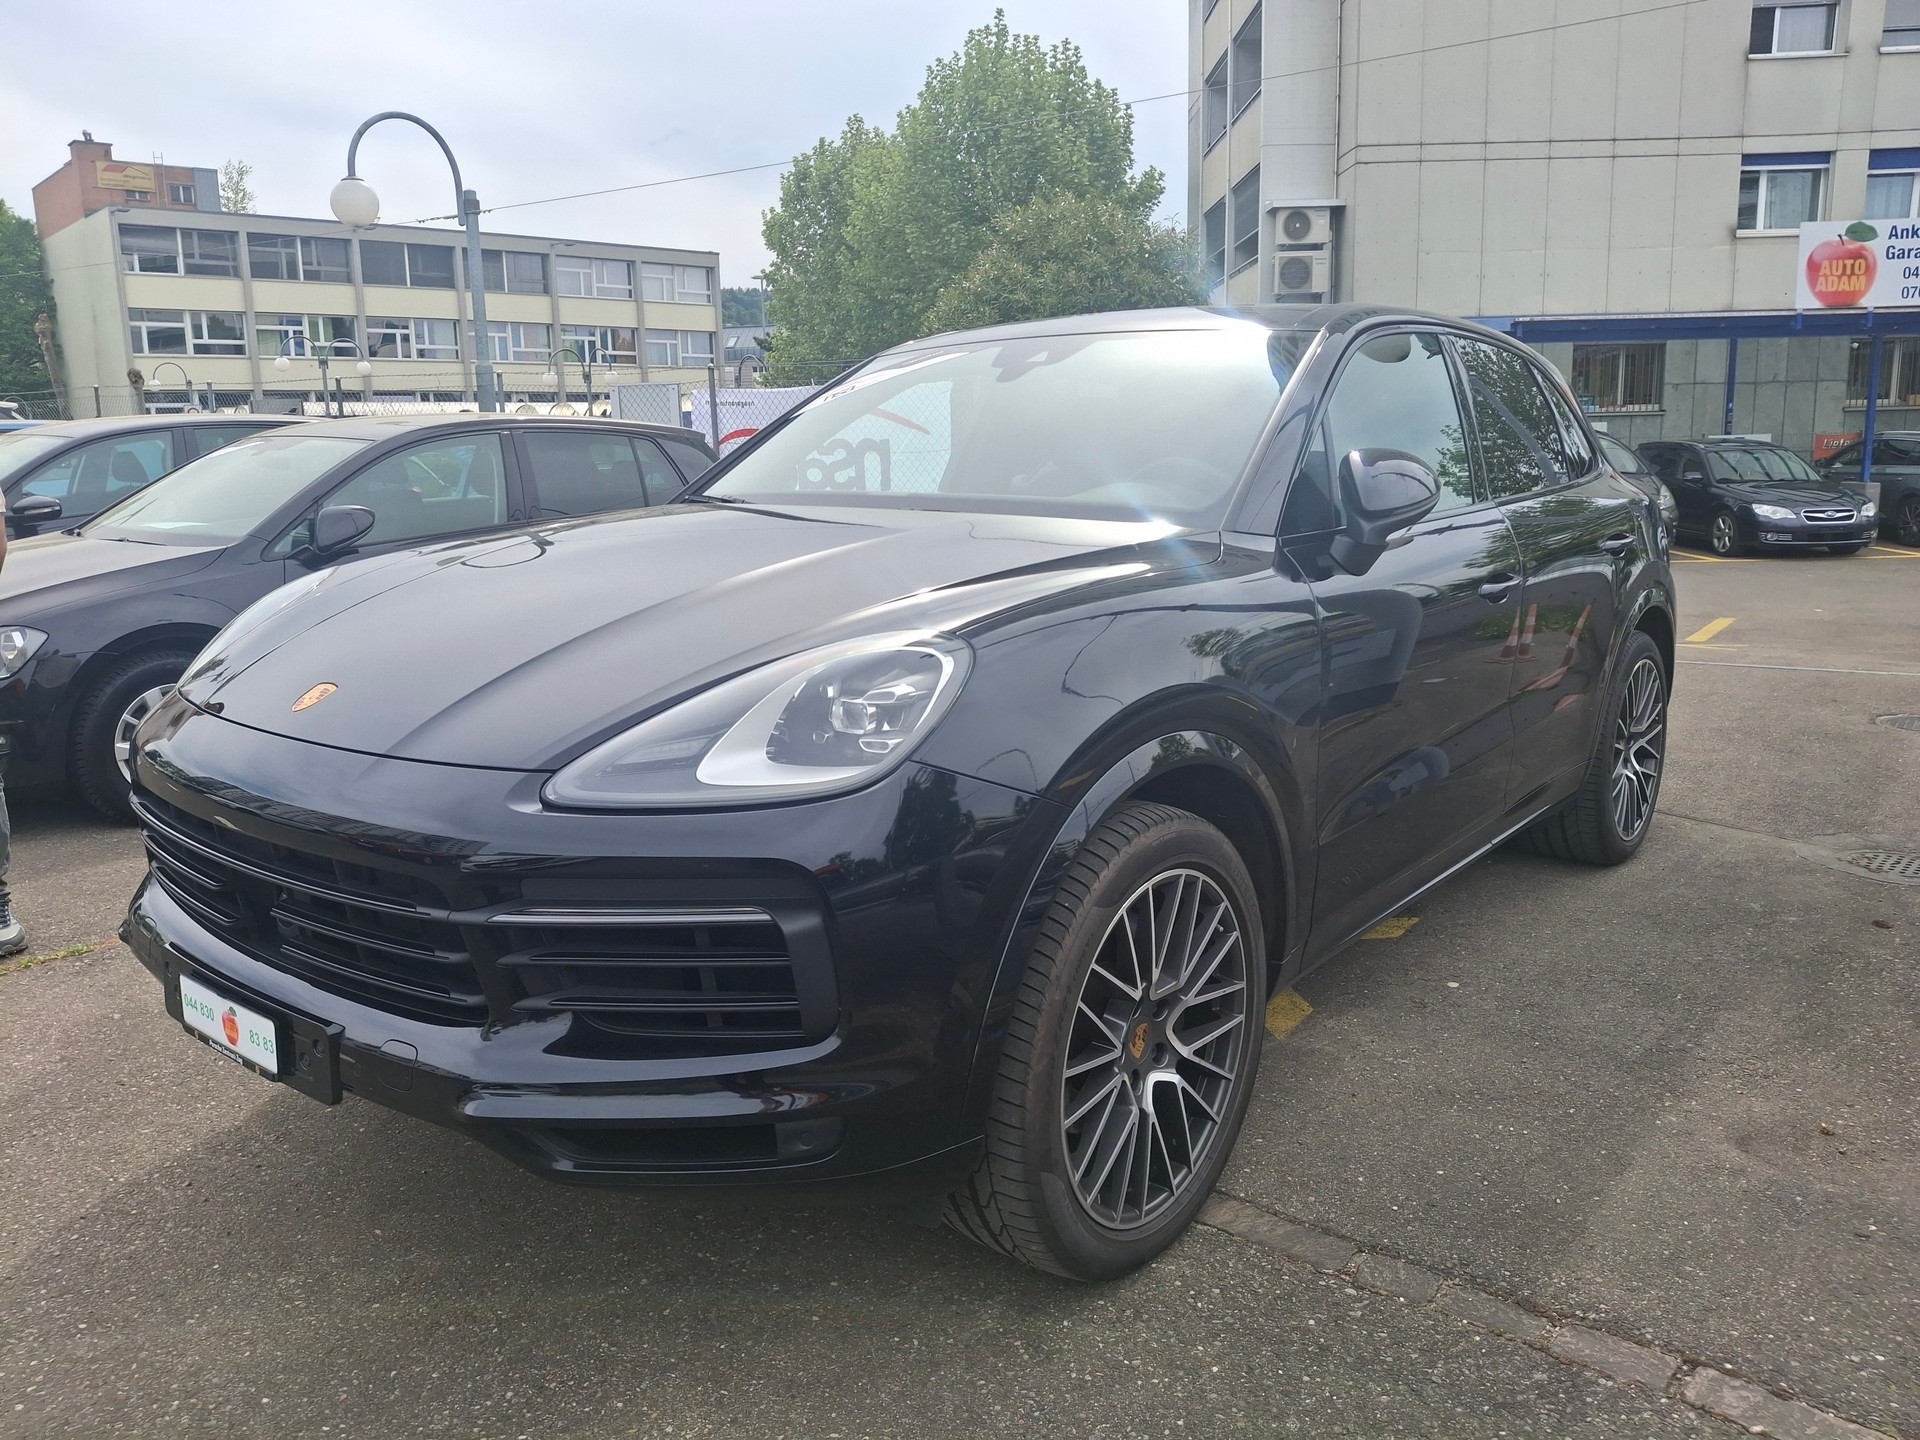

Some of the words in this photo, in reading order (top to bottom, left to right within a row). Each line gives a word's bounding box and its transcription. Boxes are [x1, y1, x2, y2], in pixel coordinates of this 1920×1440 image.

[1819, 259, 1866, 276] AUTO
[1815, 275, 1866, 292] ADAM
[1901, 285, 1920, 299] 07
[184, 993, 198, 1012] 044
[200, 1002, 214, 1021] 830
[249, 1029, 260, 1046] 83
[263, 1036, 274, 1054] 83
